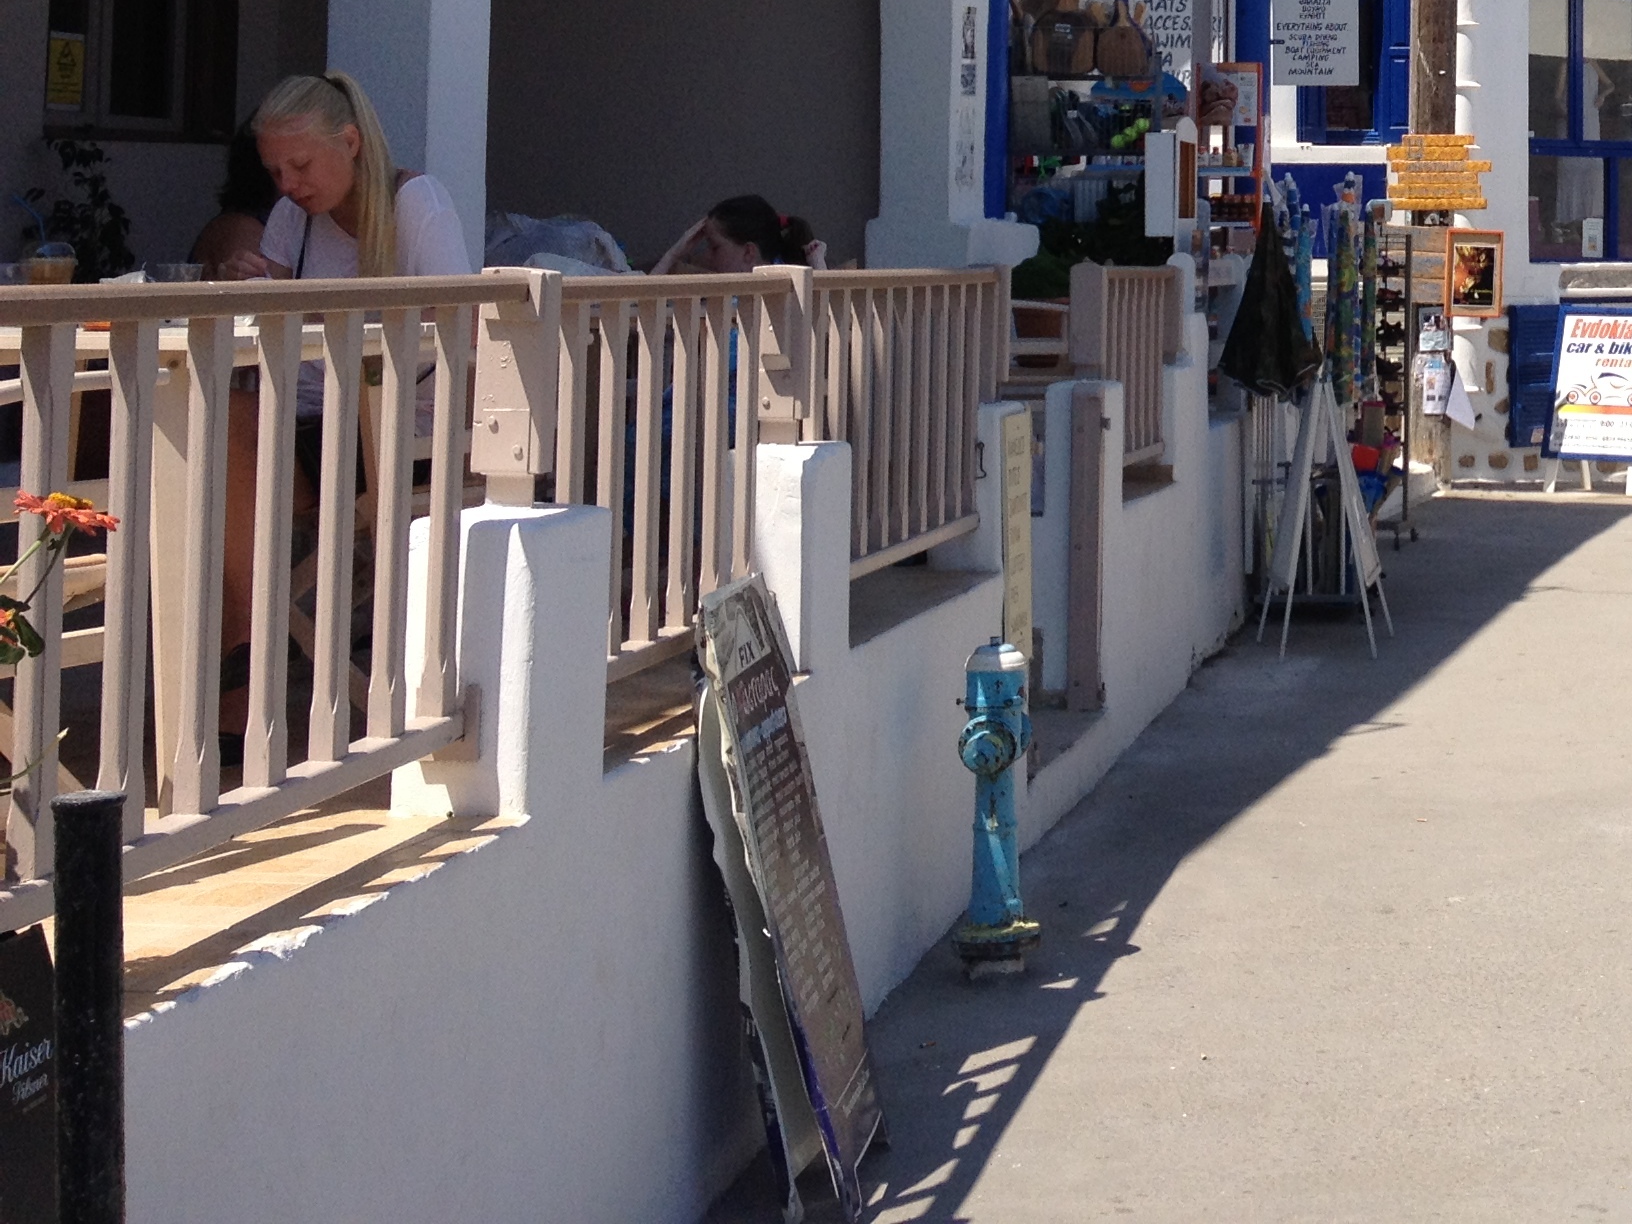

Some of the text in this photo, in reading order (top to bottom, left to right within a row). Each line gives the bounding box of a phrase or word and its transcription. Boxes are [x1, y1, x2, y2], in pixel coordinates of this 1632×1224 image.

[1276, 22, 1323, 32] EVERYTHING
[1285, 46, 1305, 54] BOAT
[1292, 54, 1330, 62] CAMPING
[1287, 67, 1335, 76] MOUNTAIN
[1566, 342, 1593, 354] car
[1594, 343, 1605, 354] &
[738, 641, 755, 668] FIX
[0, 1038, 53, 1089] Kaiser
